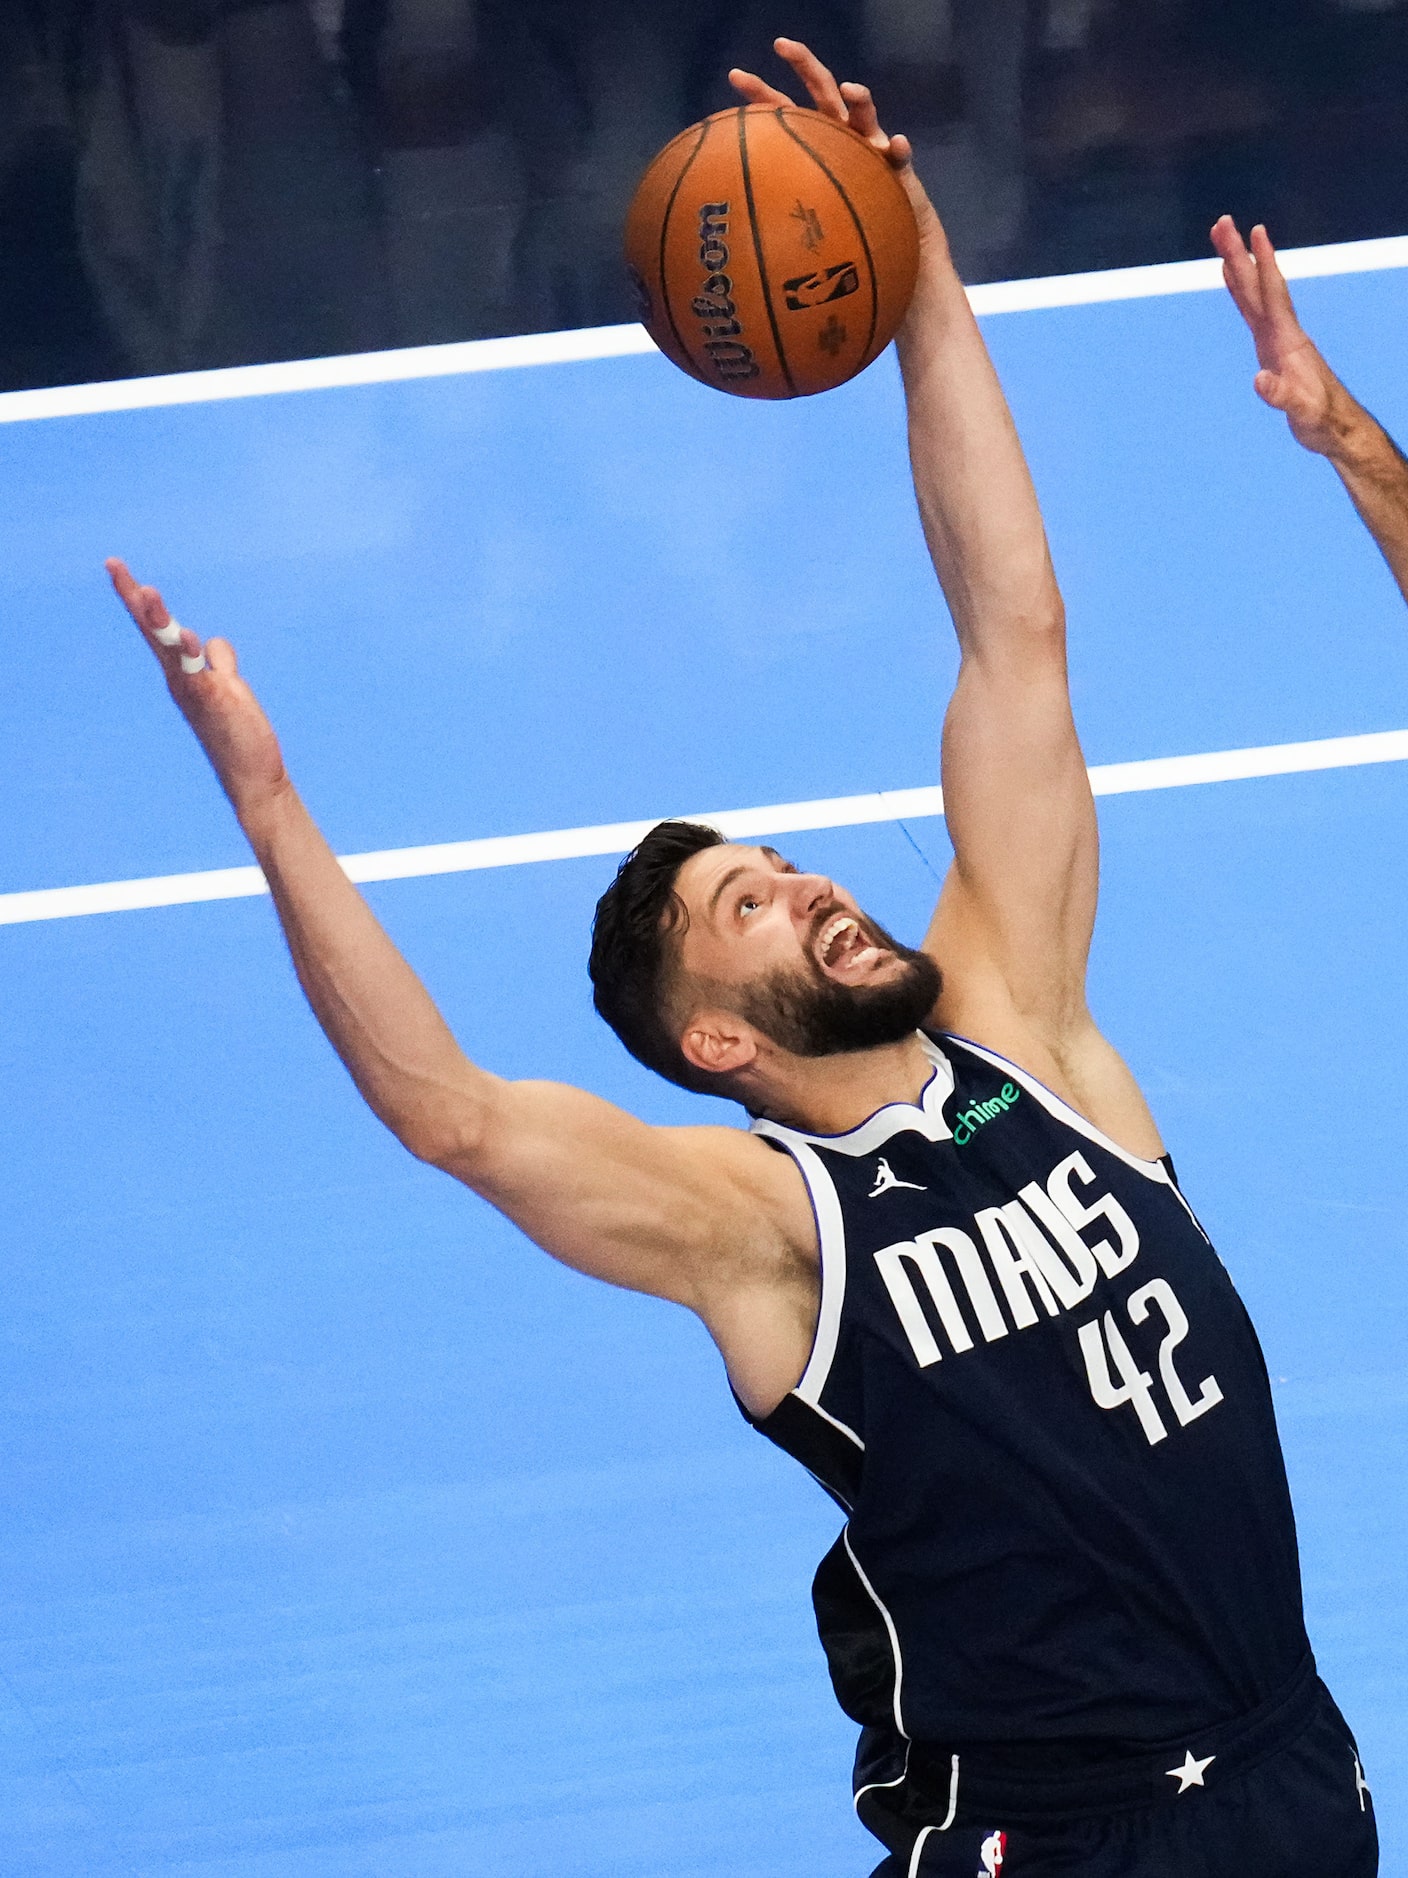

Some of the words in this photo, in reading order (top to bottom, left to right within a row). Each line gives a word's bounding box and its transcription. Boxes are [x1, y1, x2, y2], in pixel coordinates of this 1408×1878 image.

[692, 201, 760, 381] Wilson
[953, 1082, 1020, 1146] chime
[1077, 1278, 1224, 1446] 42
